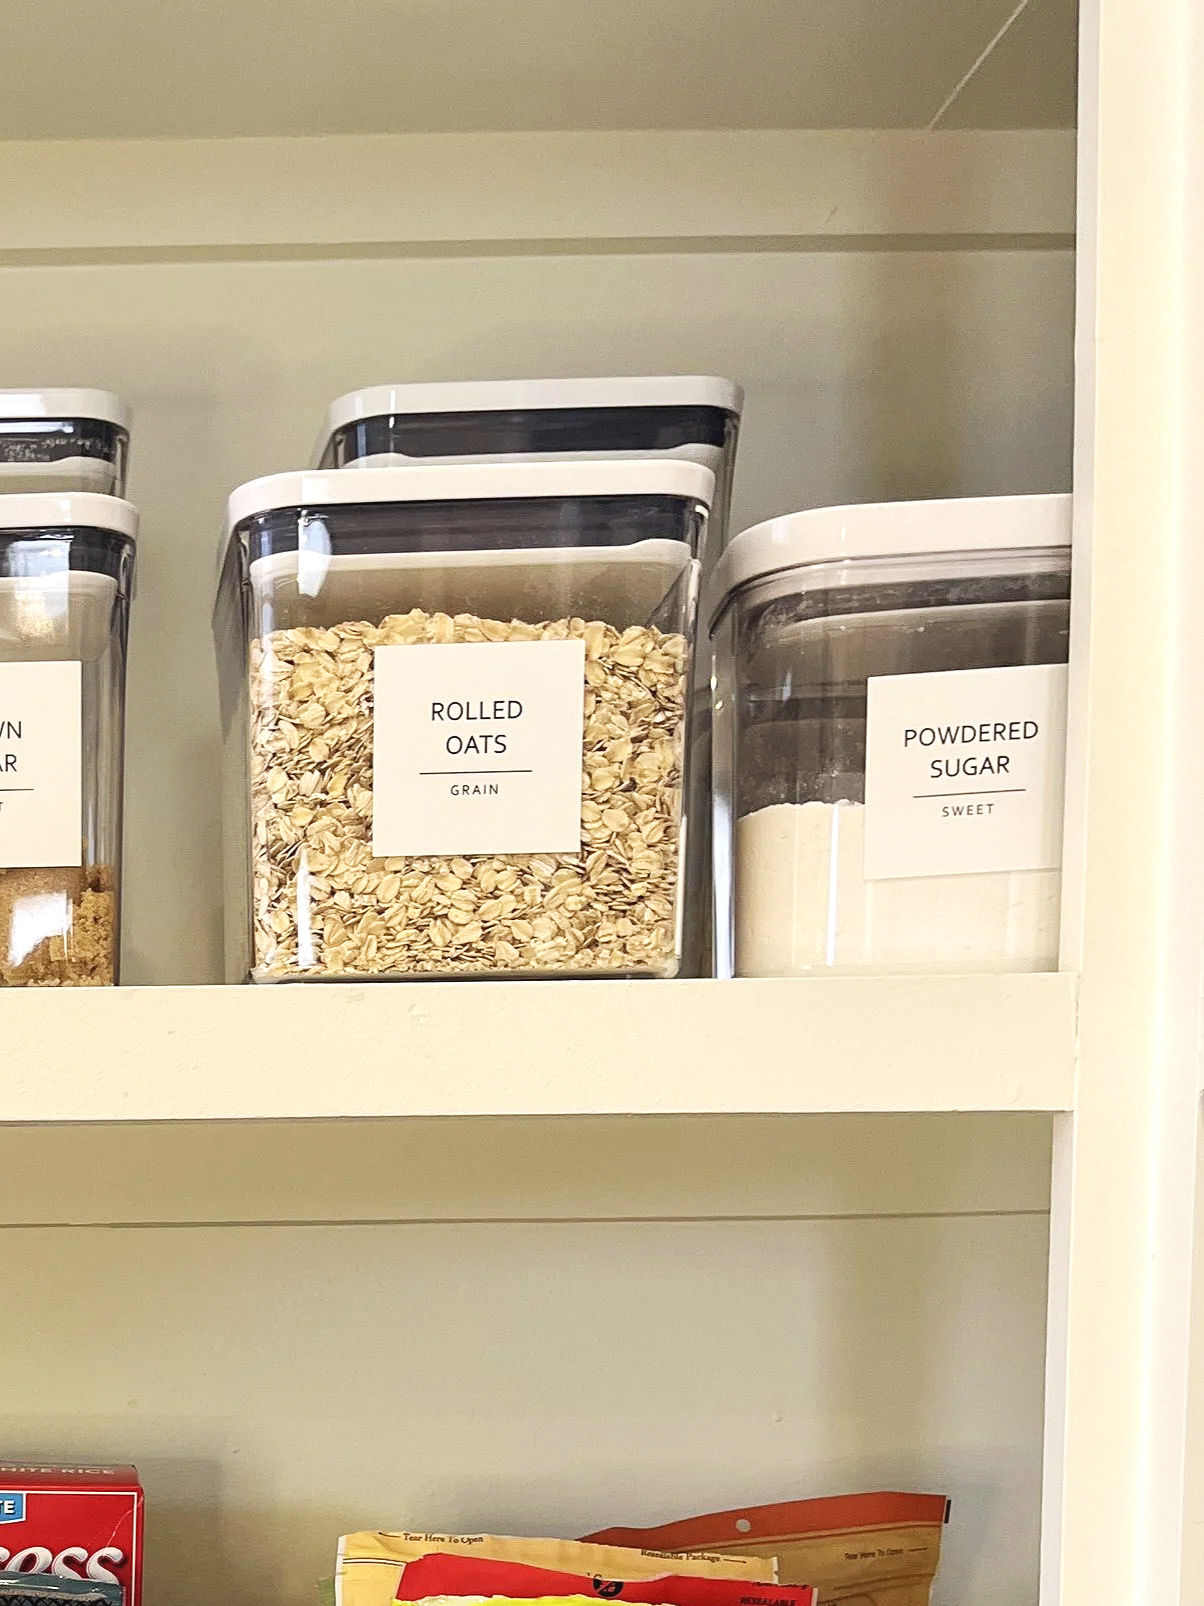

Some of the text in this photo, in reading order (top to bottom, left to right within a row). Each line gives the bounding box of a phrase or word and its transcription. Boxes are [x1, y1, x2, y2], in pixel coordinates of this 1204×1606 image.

[431, 700, 523, 721] ROLLED
[904, 721, 1039, 747] POWDERED
[446, 734, 507, 755] OATS
[930, 755, 1010, 779] SUGAR
[450, 784, 499, 796] GRAIN
[942, 803, 995, 818] SWEET
[402, 1532, 422, 1543] Tear
[424, 1534, 445, 1543] Here
[685, 1552, 721, 1564] Package
